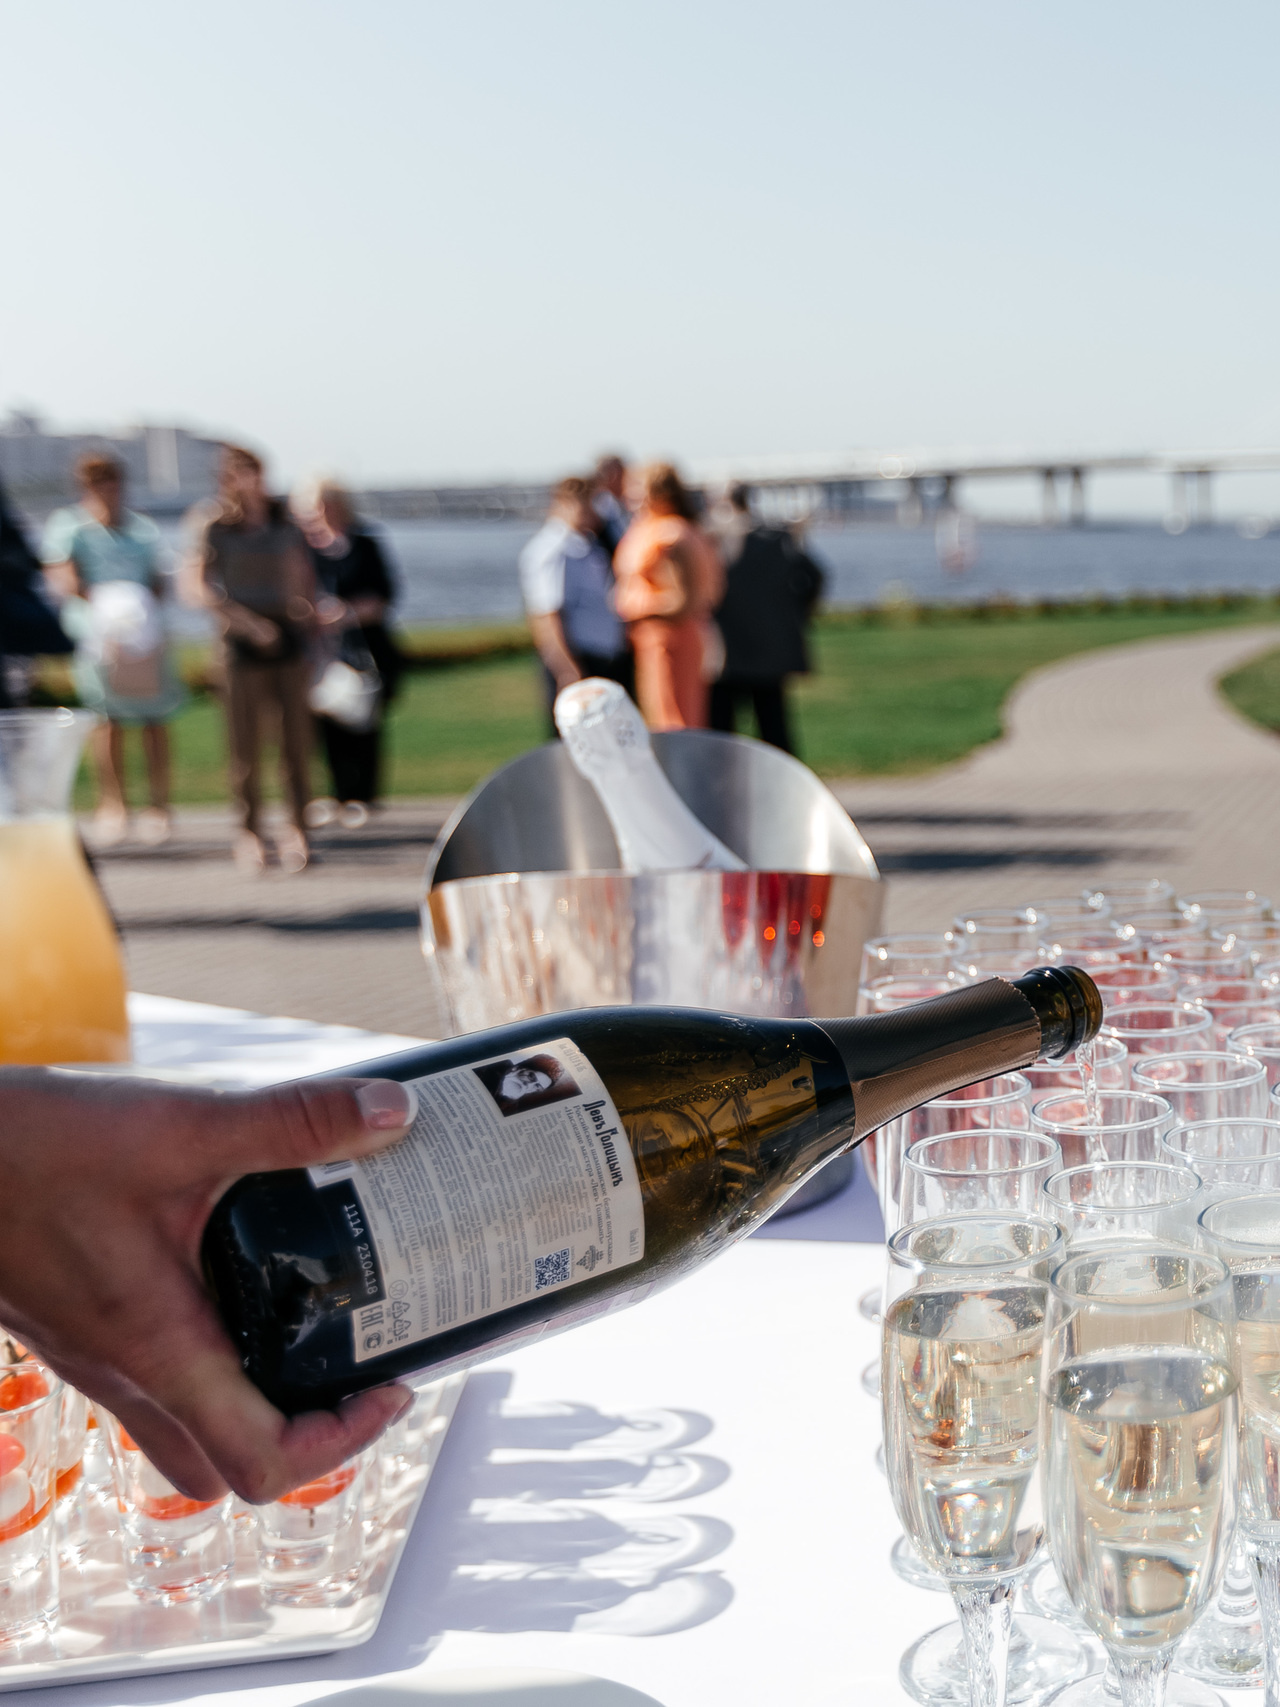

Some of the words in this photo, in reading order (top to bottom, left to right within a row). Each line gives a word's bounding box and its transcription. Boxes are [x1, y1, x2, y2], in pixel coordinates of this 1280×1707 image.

[563, 1104, 584, 1145] «Наследие
[579, 1145, 594, 1177] мастера
[572, 1104, 594, 1148] Российское
[590, 1148, 608, 1196] шампанское
[603, 1196, 611, 1220] белое
[582, 1100, 606, 1130] Левъ
[595, 1127, 624, 1187] Голицынъ
[343, 1202, 365, 1237] 111A
[356, 1242, 378, 1295] 23.04.18
